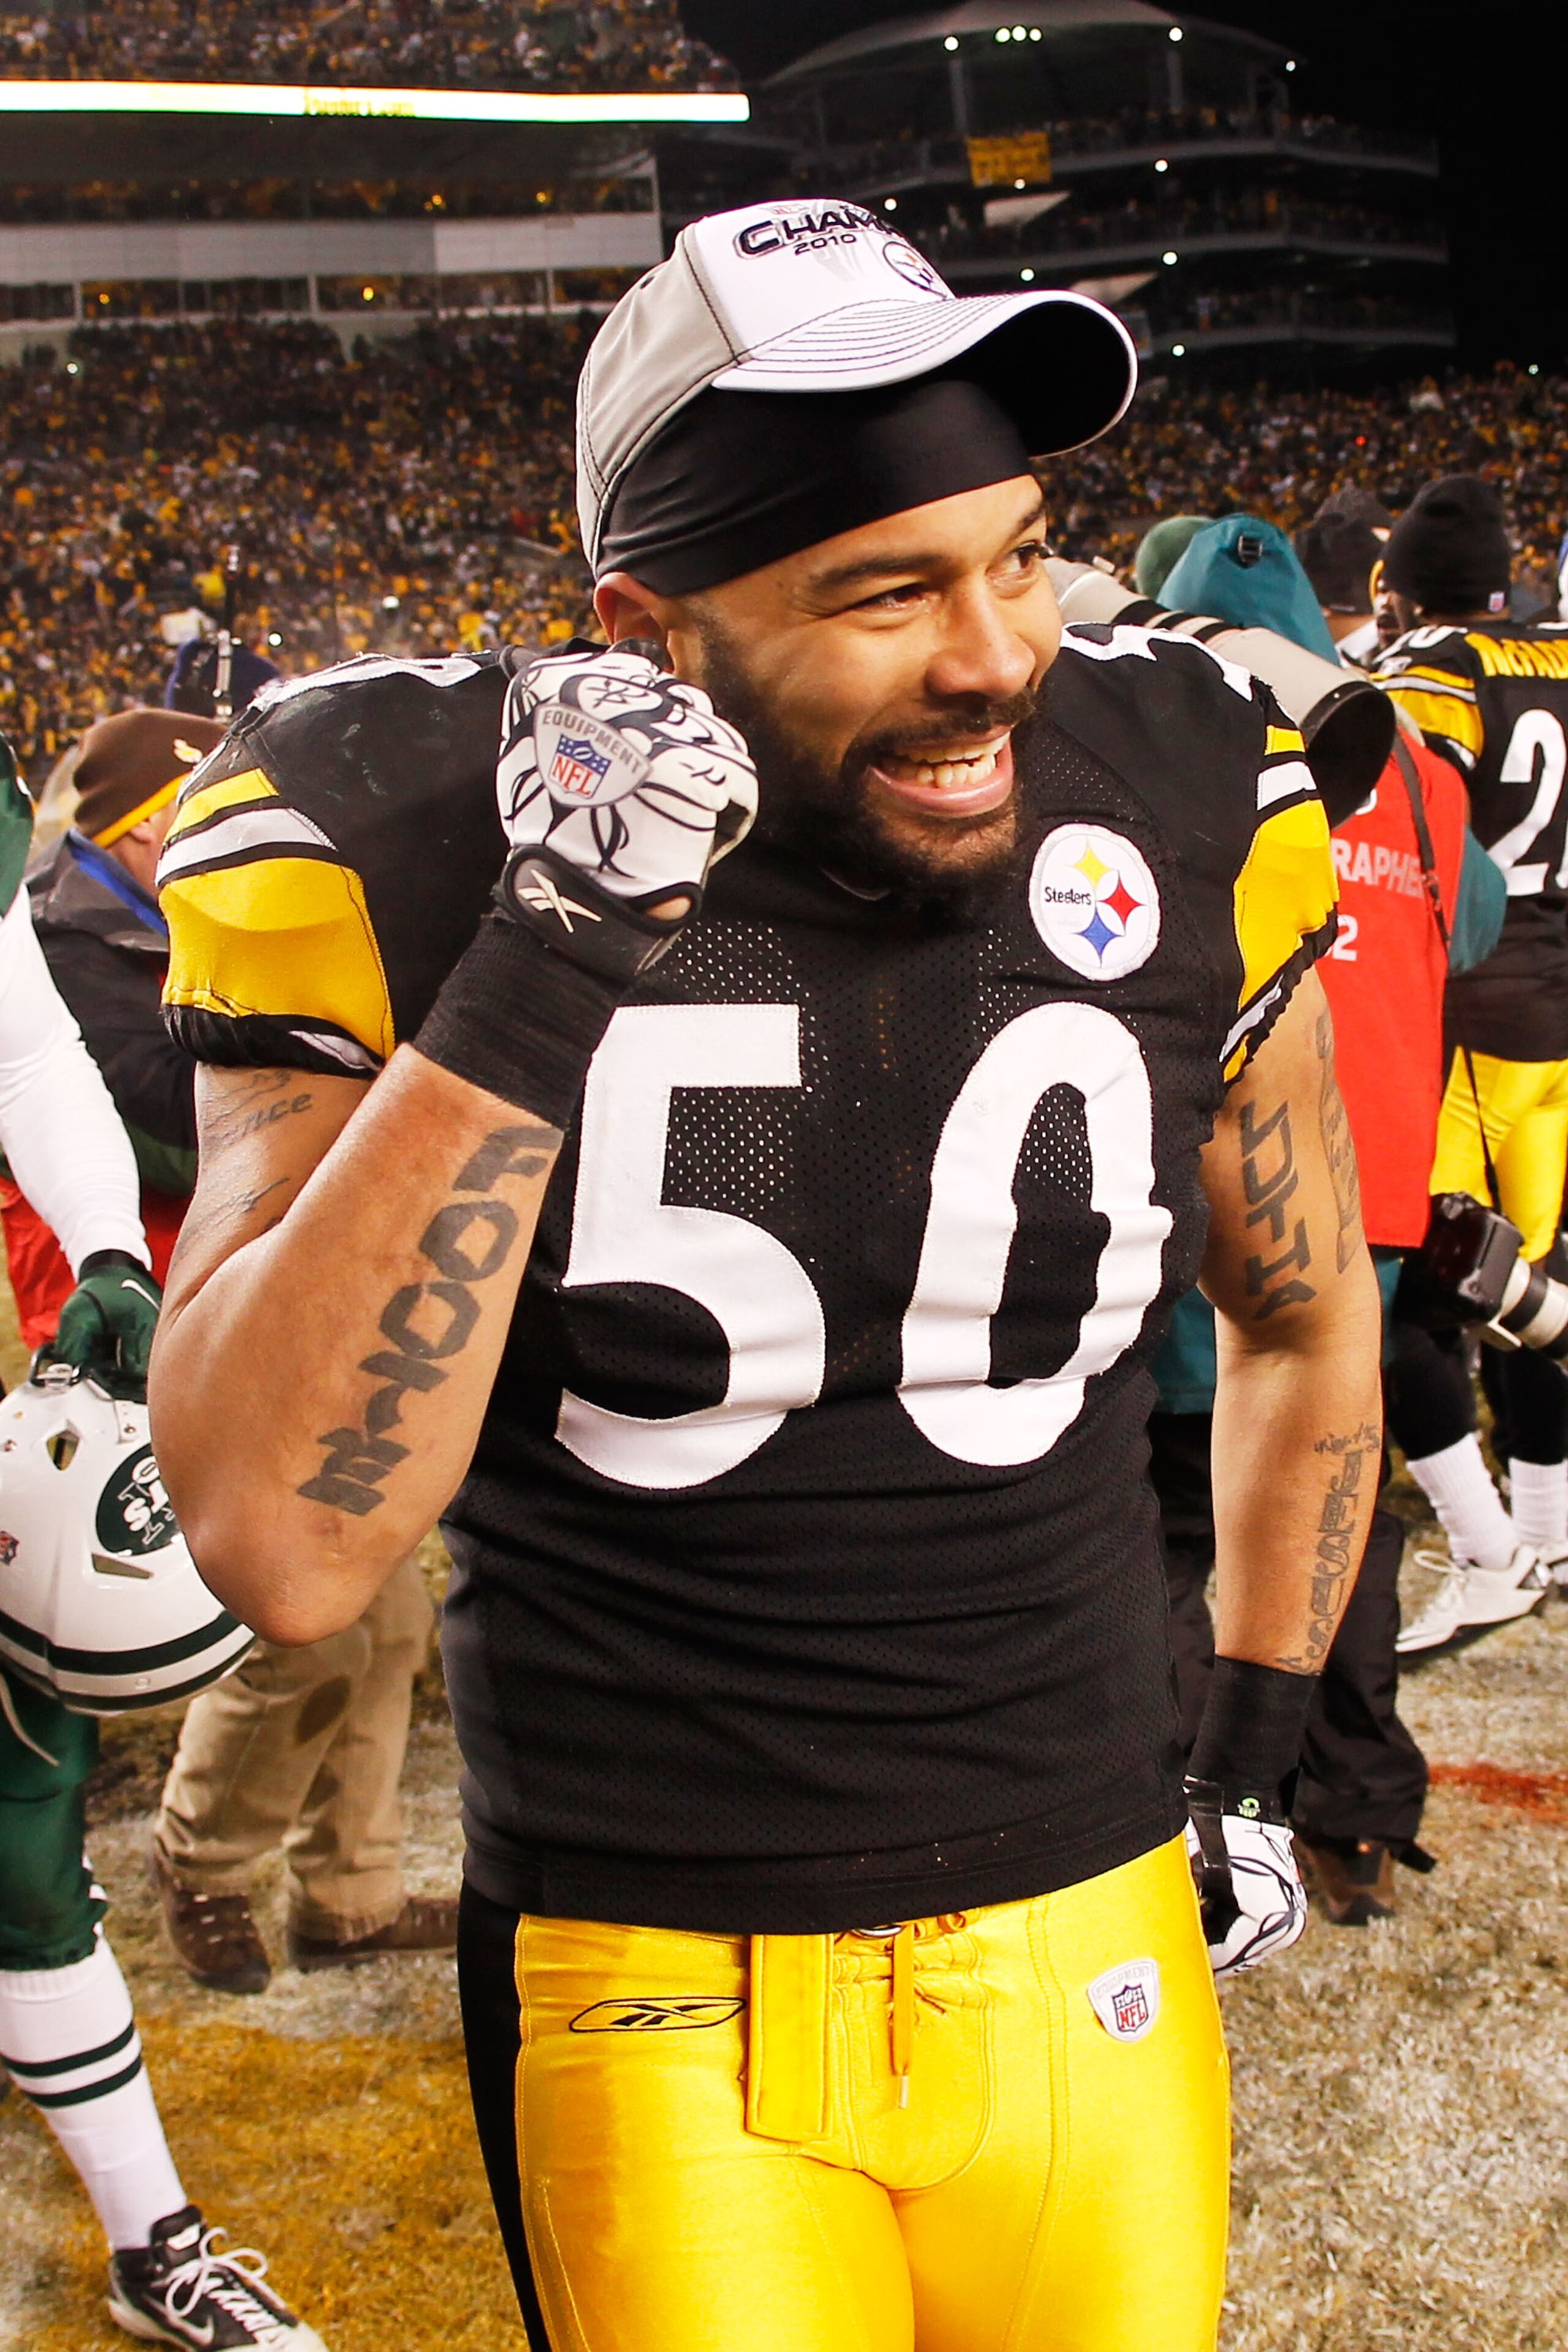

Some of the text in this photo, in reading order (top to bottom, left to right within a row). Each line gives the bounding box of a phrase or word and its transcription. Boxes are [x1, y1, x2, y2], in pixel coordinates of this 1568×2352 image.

[793, 233, 856, 255] 2010
[542, 710, 643, 774] EQUIPMENT
[552, 755, 594, 796] NFL
[1044, 886, 1091, 905] Steelers
[554, 1001, 1174, 1490] 50
[1305, 1450, 1362, 1660] JESUS
[1118, 2000, 1147, 2029] NFL
